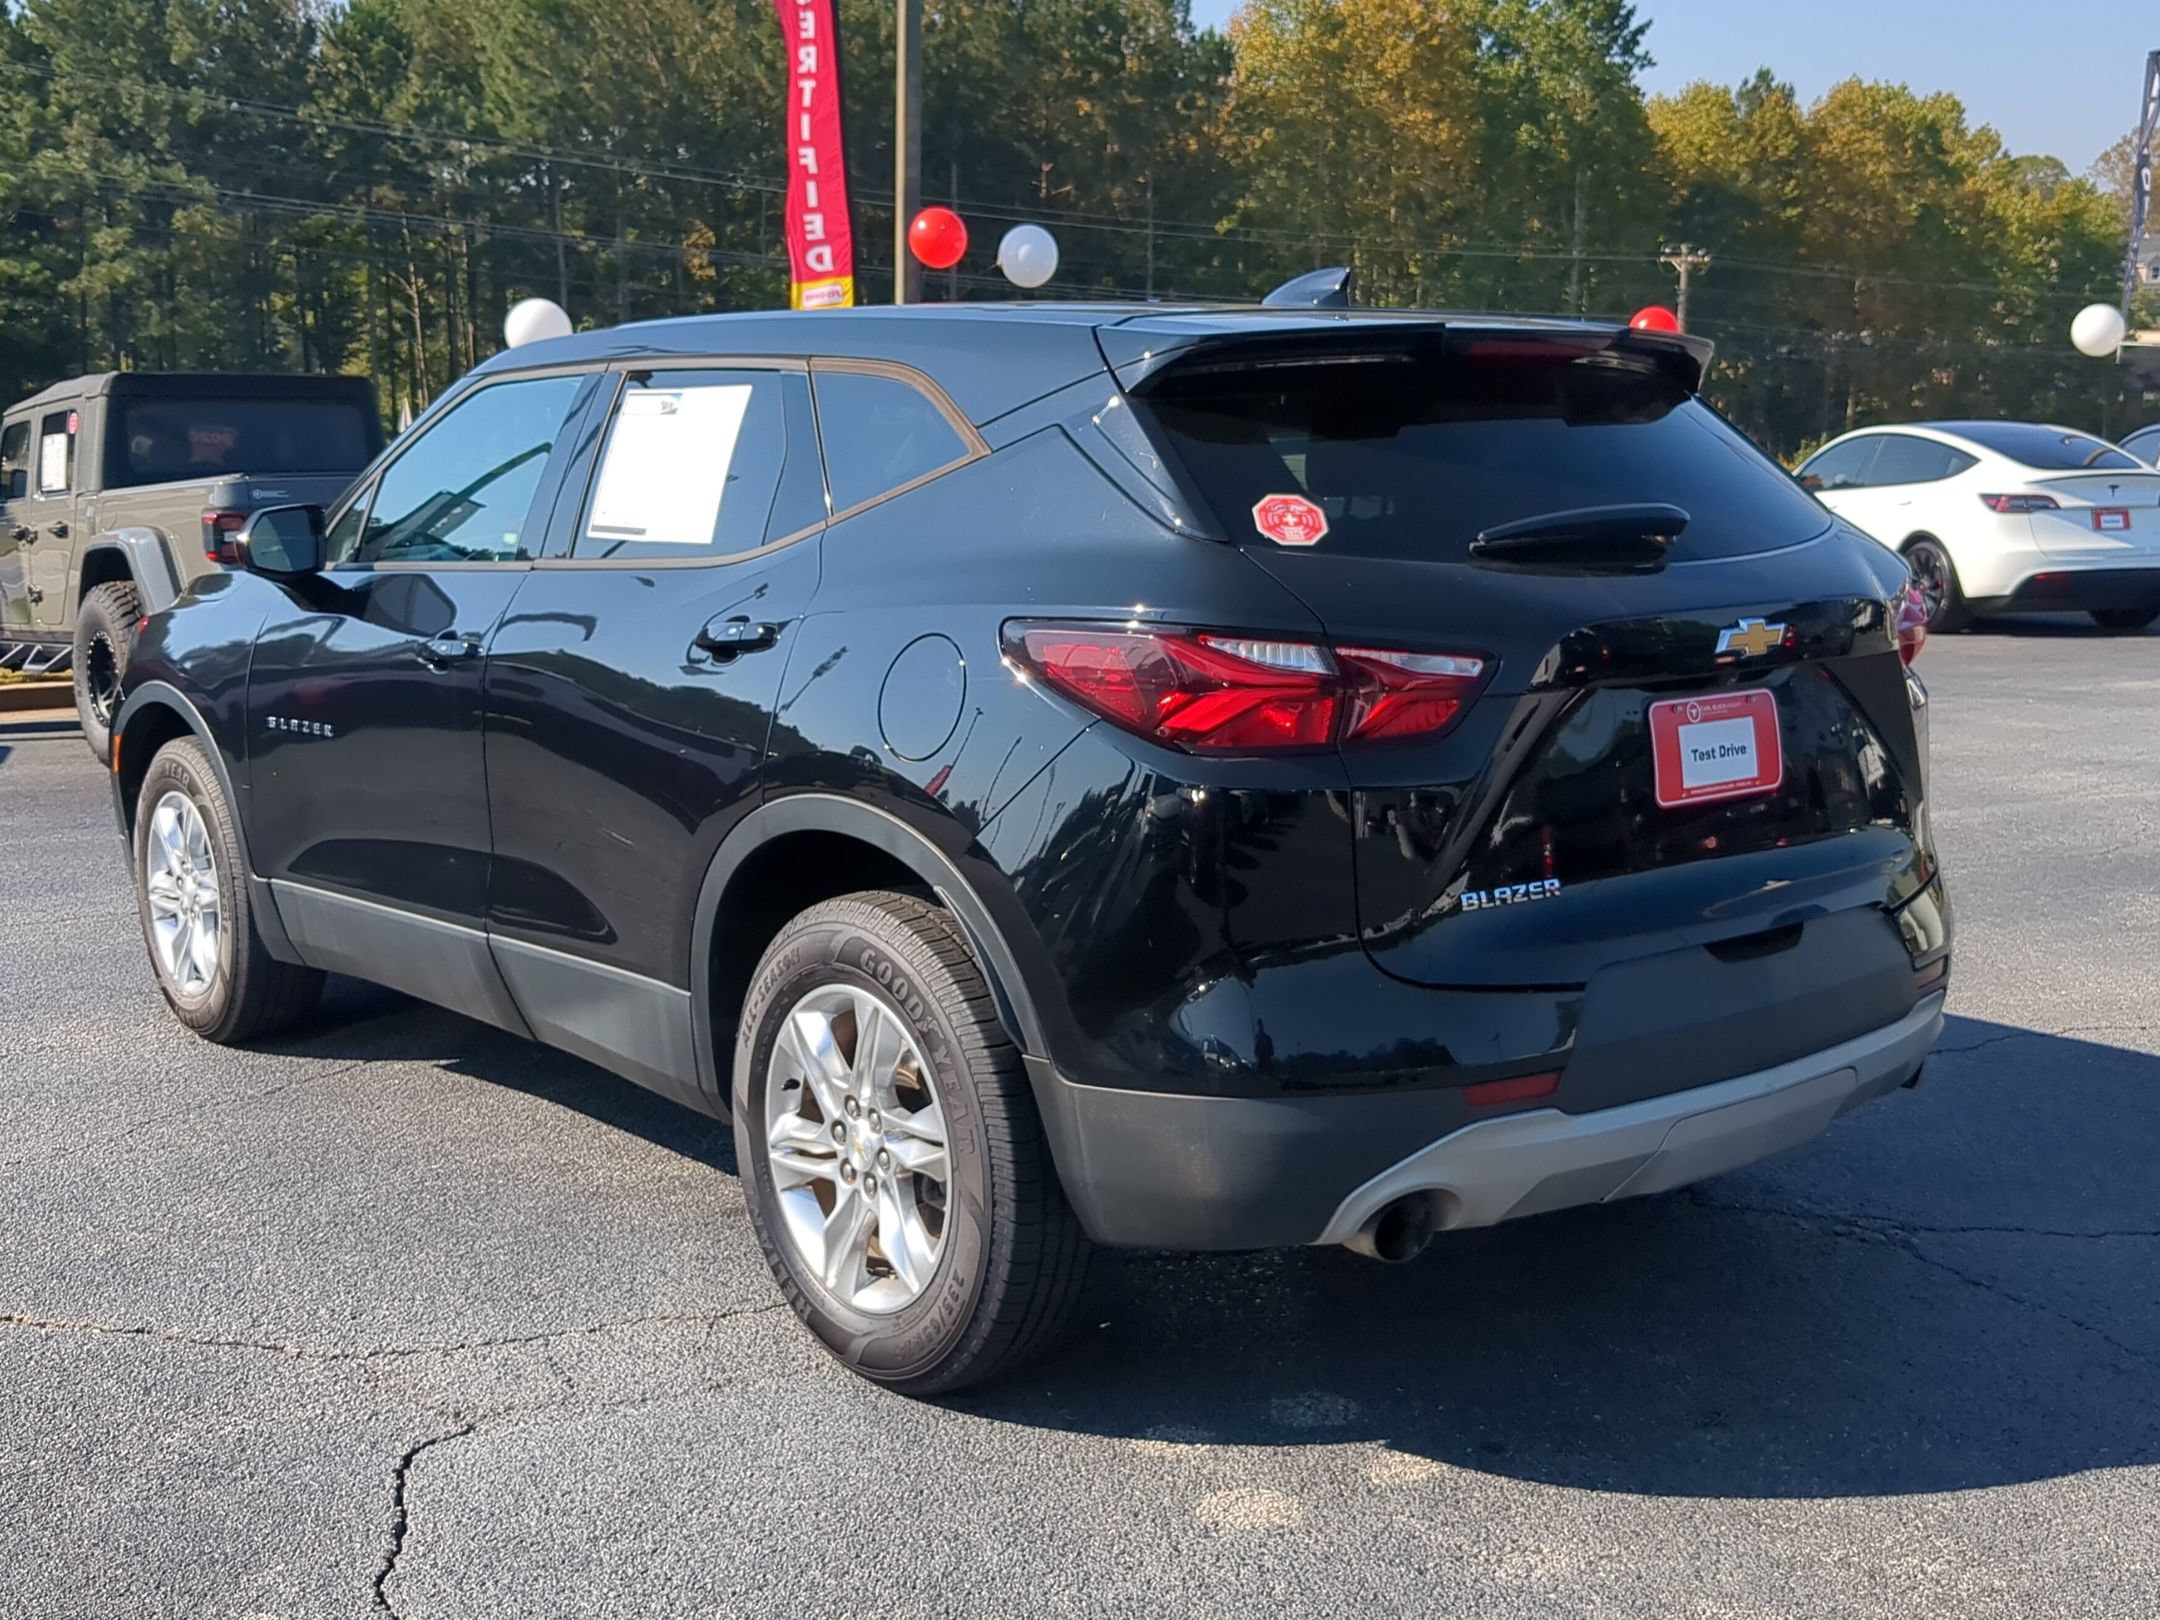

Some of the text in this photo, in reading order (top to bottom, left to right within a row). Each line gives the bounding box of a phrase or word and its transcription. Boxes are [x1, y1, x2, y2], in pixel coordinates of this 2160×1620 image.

[266, 716, 334, 737] BLAZER
[1691, 743, 1747, 762] Test Drive
[1460, 878, 1561, 911] BLAZER
